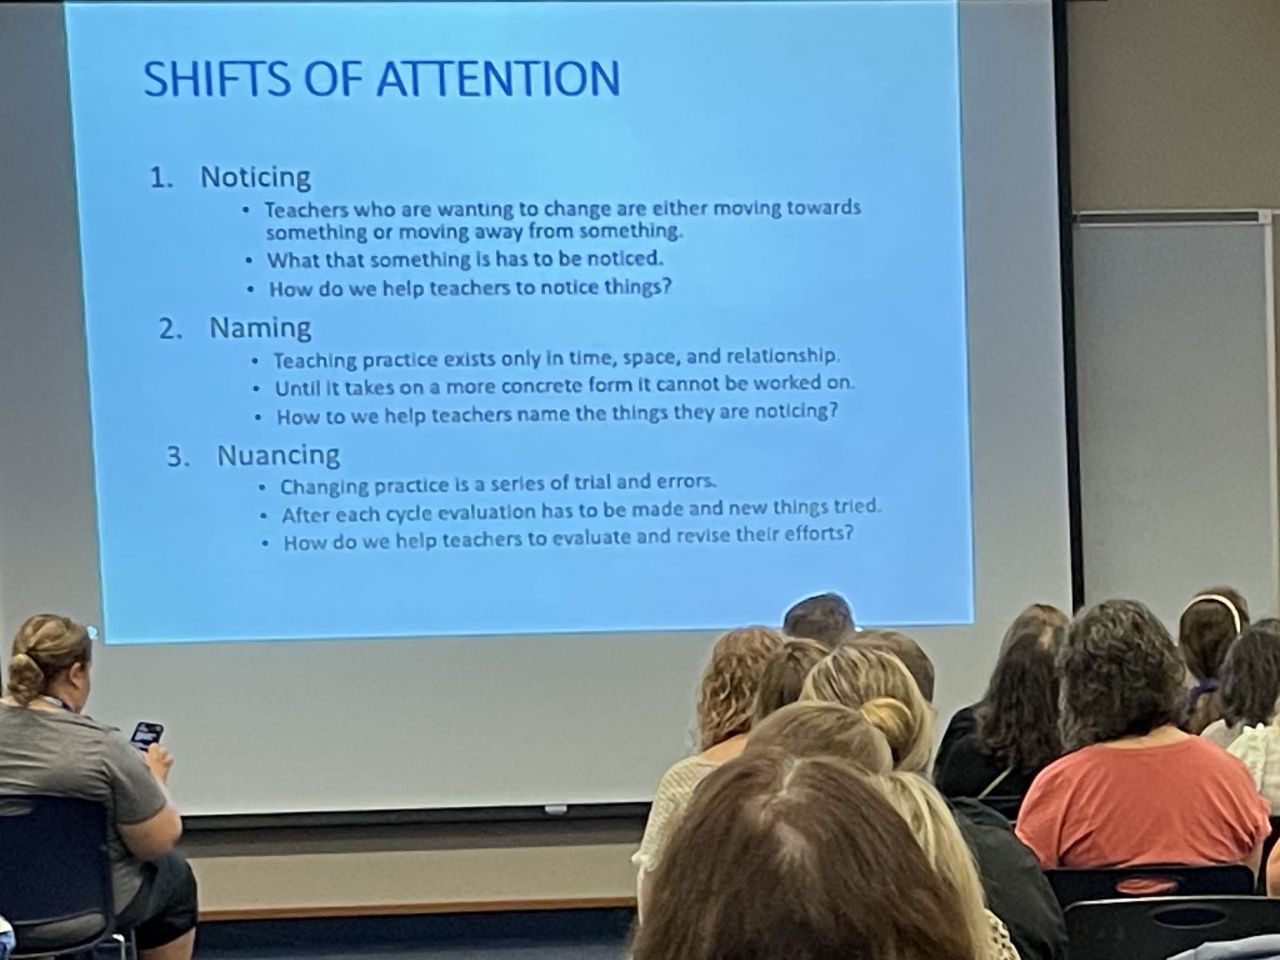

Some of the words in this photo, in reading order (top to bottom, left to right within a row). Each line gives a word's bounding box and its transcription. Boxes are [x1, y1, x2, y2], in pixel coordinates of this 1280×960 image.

[145, 60, 291, 98] SHIFTS
[305, 60, 362, 97] OF
[377, 59, 619, 97] ATTENTION
[152, 165, 173, 188] 1.
[202, 165, 311, 194] Noticing
[264, 200, 349, 219] Teachers
[353, 200, 396, 217] who
[402, 204, 431, 218] are
[438, 202, 514, 221] wanting
[519, 201, 538, 217] to
[544, 199, 611, 221] change
[617, 203, 647, 217] are
[653, 199, 708, 217] either
[714, 200, 782, 220] moving
[787, 198, 861, 216] towards
[267, 222, 368, 244] something
[373, 226, 393, 240] or
[399, 223, 469, 244] moving
[475, 226, 523, 244] away
[529, 221, 574, 240] from
[580, 221, 683, 243] something.
[267, 251, 320, 269] What
[326, 250, 365, 269] that
[371, 250, 471, 272] something
[477, 250, 490, 267] is
[496, 249, 528, 267] has
[533, 252, 553, 267] to
[559, 249, 582, 267] be
[588, 249, 664, 267] noticed.
[270, 281, 313, 297] How
[319, 280, 343, 297] do
[349, 284, 376, 297] we
[383, 279, 424, 300] help
[430, 278, 510, 297] teachers
[516, 281, 536, 296] to
[541, 278, 599, 295] notice
[605, 277, 672, 299] things?
[160, 316, 182, 339] 2.
[211, 315, 312, 344] Naming
[273, 351, 357, 373] Teaching
[363, 352, 438, 372] practice
[444, 351, 496, 368] exists
[501, 349, 541, 371] only
[547, 350, 564, 366] in
[569, 349, 617, 369] time,
[623, 351, 681, 369] space,
[687, 347, 721, 364] and
[727, 347, 840, 367] relationship.
[276, 379, 320, 397] Until
[327, 380, 340, 397] it
[345, 379, 395, 397] takes
[400, 382, 424, 395] on
[430, 382, 440, 395] a
[447, 382, 495, 395] more
[502, 379, 583, 395] concrete
[589, 376, 633, 393] form
[639, 376, 651, 392] it
[656, 376, 720, 392] cannot
[725, 374, 748, 392] be
[754, 373, 821, 390] worked
[827, 378, 855, 390] on.
[277, 408, 320, 426] How
[326, 411, 345, 425] to
[351, 411, 378, 424] we
[385, 406, 426, 428] help
[432, 405, 512, 424] teachers
[518, 408, 570, 422] name
[576, 404, 606, 422] the
[612, 404, 668, 425] things
[674, 402, 715, 424] they
[720, 406, 749, 420] are
[755, 401, 838, 422] noticing?
[168, 445, 189, 467] 3.
[218, 443, 340, 471] Nuancing
[281, 478, 369, 500] Changing
[375, 477, 449, 497] practice
[455, 477, 469, 493] is
[475, 479, 485, 492] a
[491, 476, 545, 492] series
[551, 473, 569, 491] of
[575, 472, 611, 491] trial
[617, 472, 651, 490] and
[657, 476, 717, 489] errors.
[282, 506, 330, 524] After
[336, 505, 380, 524] each
[386, 503, 431, 526] cycle
[438, 503, 536, 521] evaluation
[542, 502, 573, 520] has
[579, 503, 598, 519] to
[603, 501, 626, 519] be
[632, 499, 683, 517] made
[690, 499, 723, 516] and
[729, 502, 768, 516] new
[774, 498, 829, 519] things
[834, 497, 881, 514] tried.
[285, 535, 327, 551] How
[333, 532, 357, 550] do
[363, 536, 390, 550] we
[396, 531, 437, 552] help
[443, 531, 522, 548] teachers
[528, 532, 547, 547] to
[553, 528, 631, 547] evaluate
[637, 526, 670, 545] and
[677, 527, 730, 544] revise
[736, 525, 780, 543] their
[785, 523, 854, 542] efforts?
